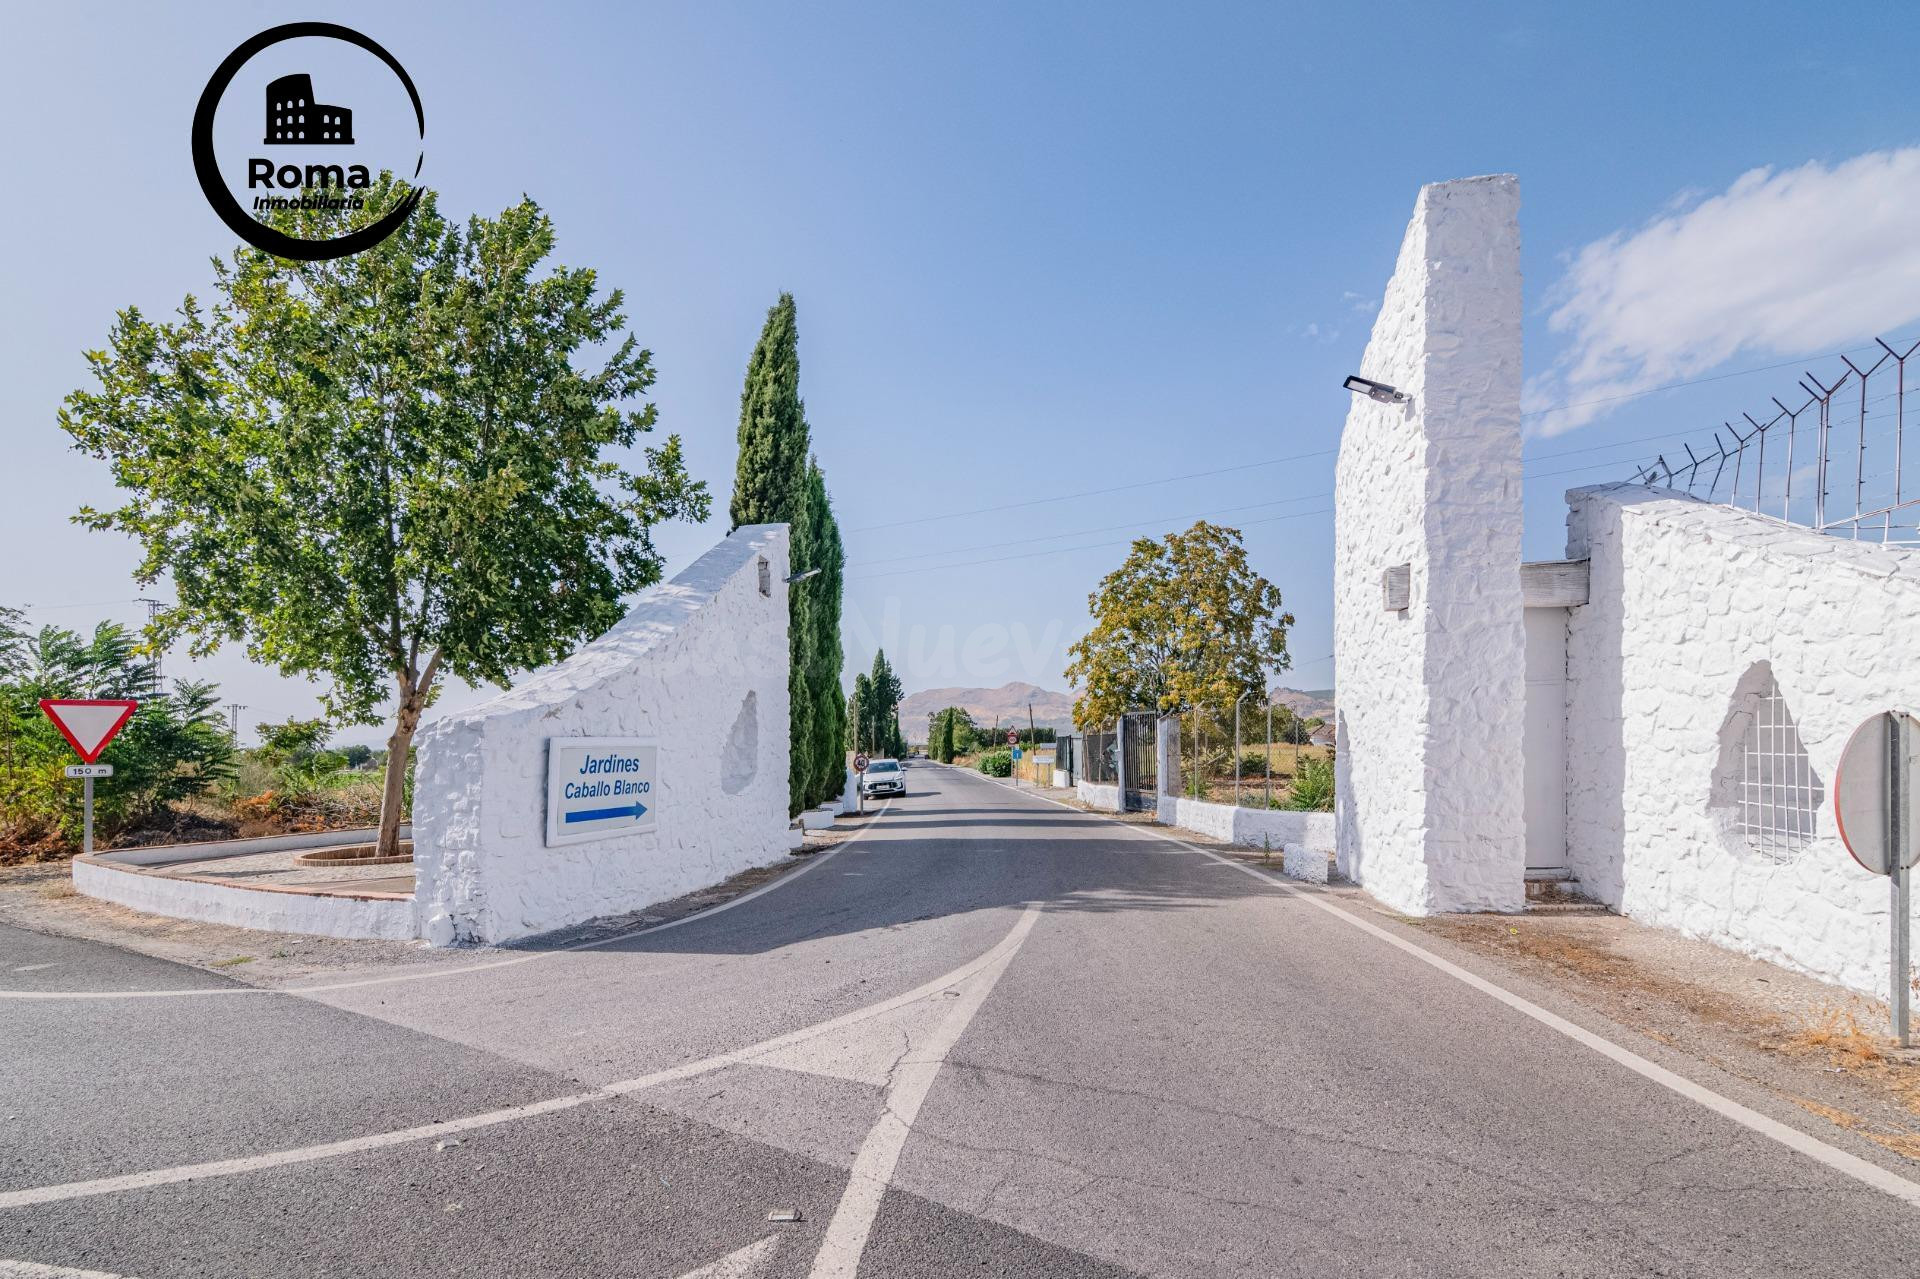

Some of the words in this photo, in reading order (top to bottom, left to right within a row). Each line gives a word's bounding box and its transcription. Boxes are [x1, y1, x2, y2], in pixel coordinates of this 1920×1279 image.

[73, 767, 92, 775] 150
[580, 754, 639, 774] Jardines
[565, 781, 611, 799] Caballo
[614, 779, 650, 795] Blanco
